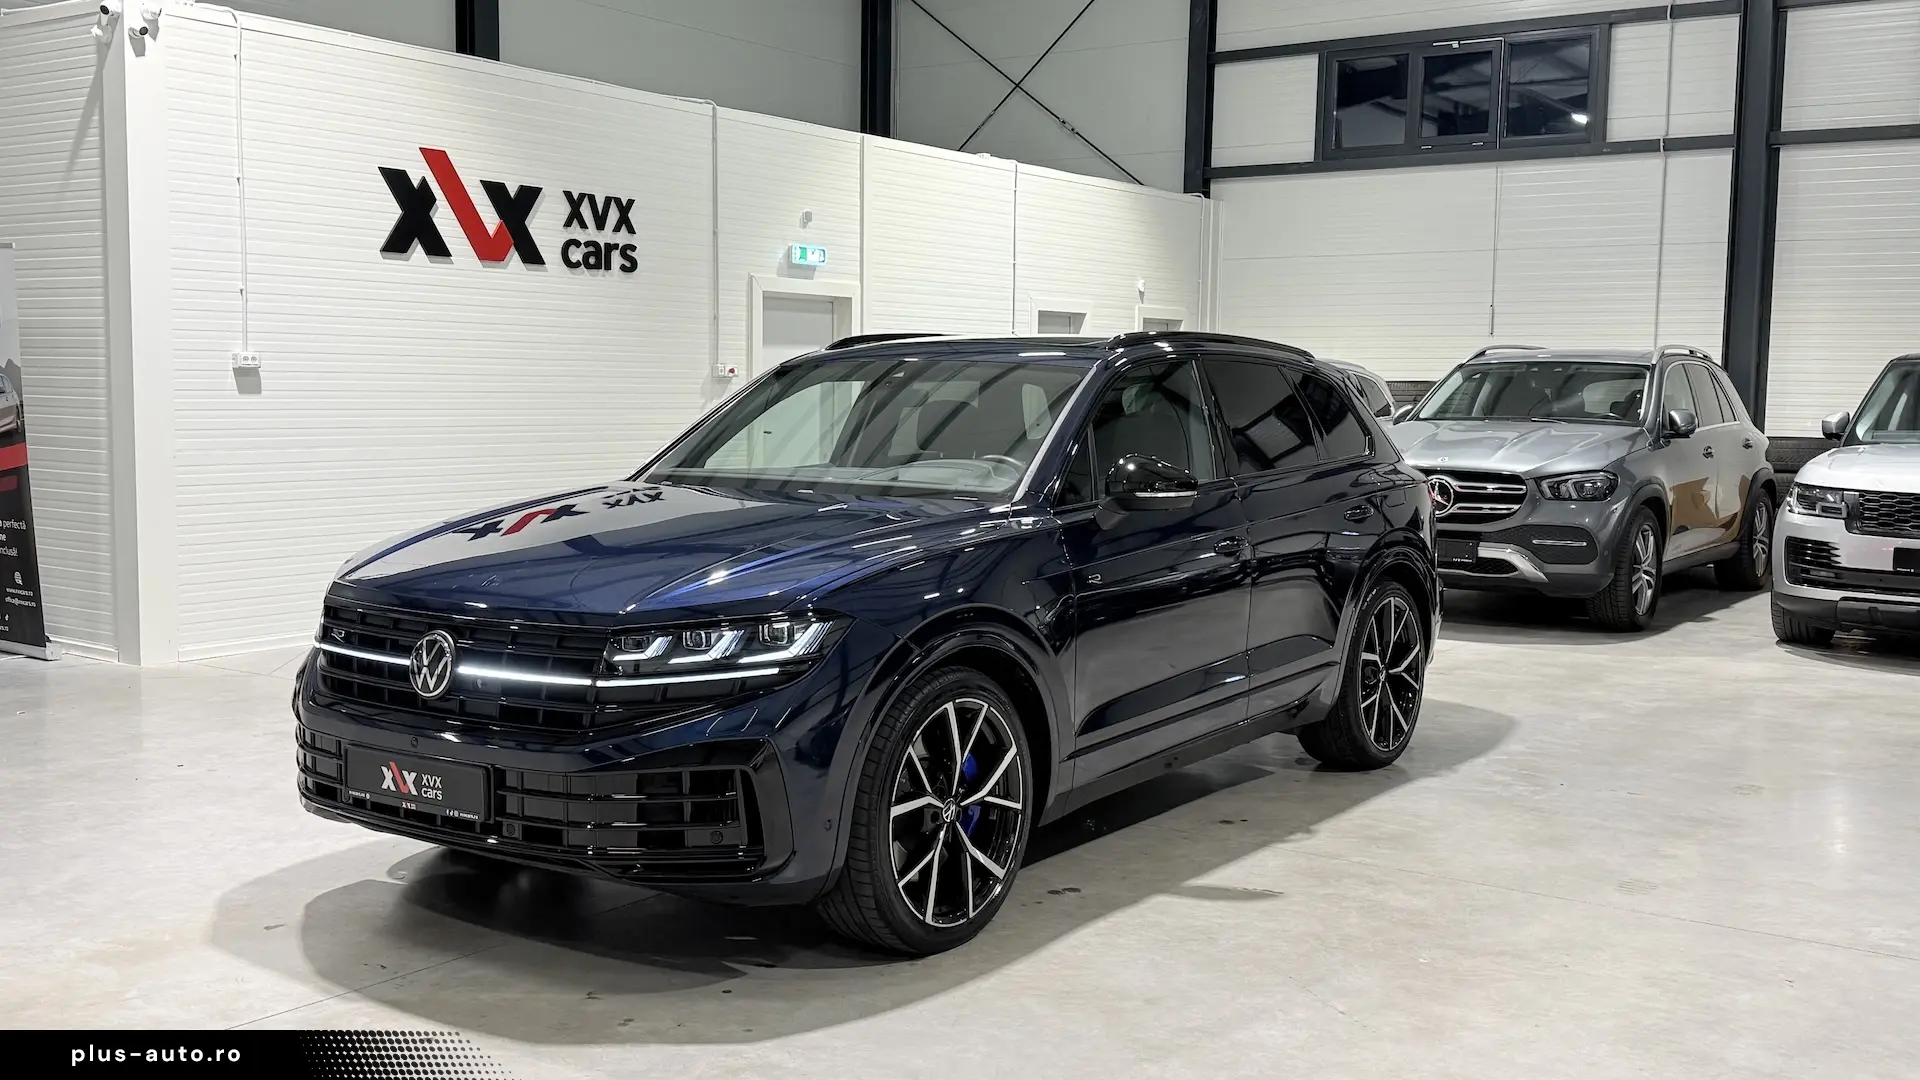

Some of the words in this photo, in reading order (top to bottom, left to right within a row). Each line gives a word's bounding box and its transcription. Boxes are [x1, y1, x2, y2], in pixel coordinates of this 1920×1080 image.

[562, 190, 637, 234] XVX
[561, 238, 638, 273] cars
[421, 773, 442, 789] XVX
[421, 787, 443, 801] cars
